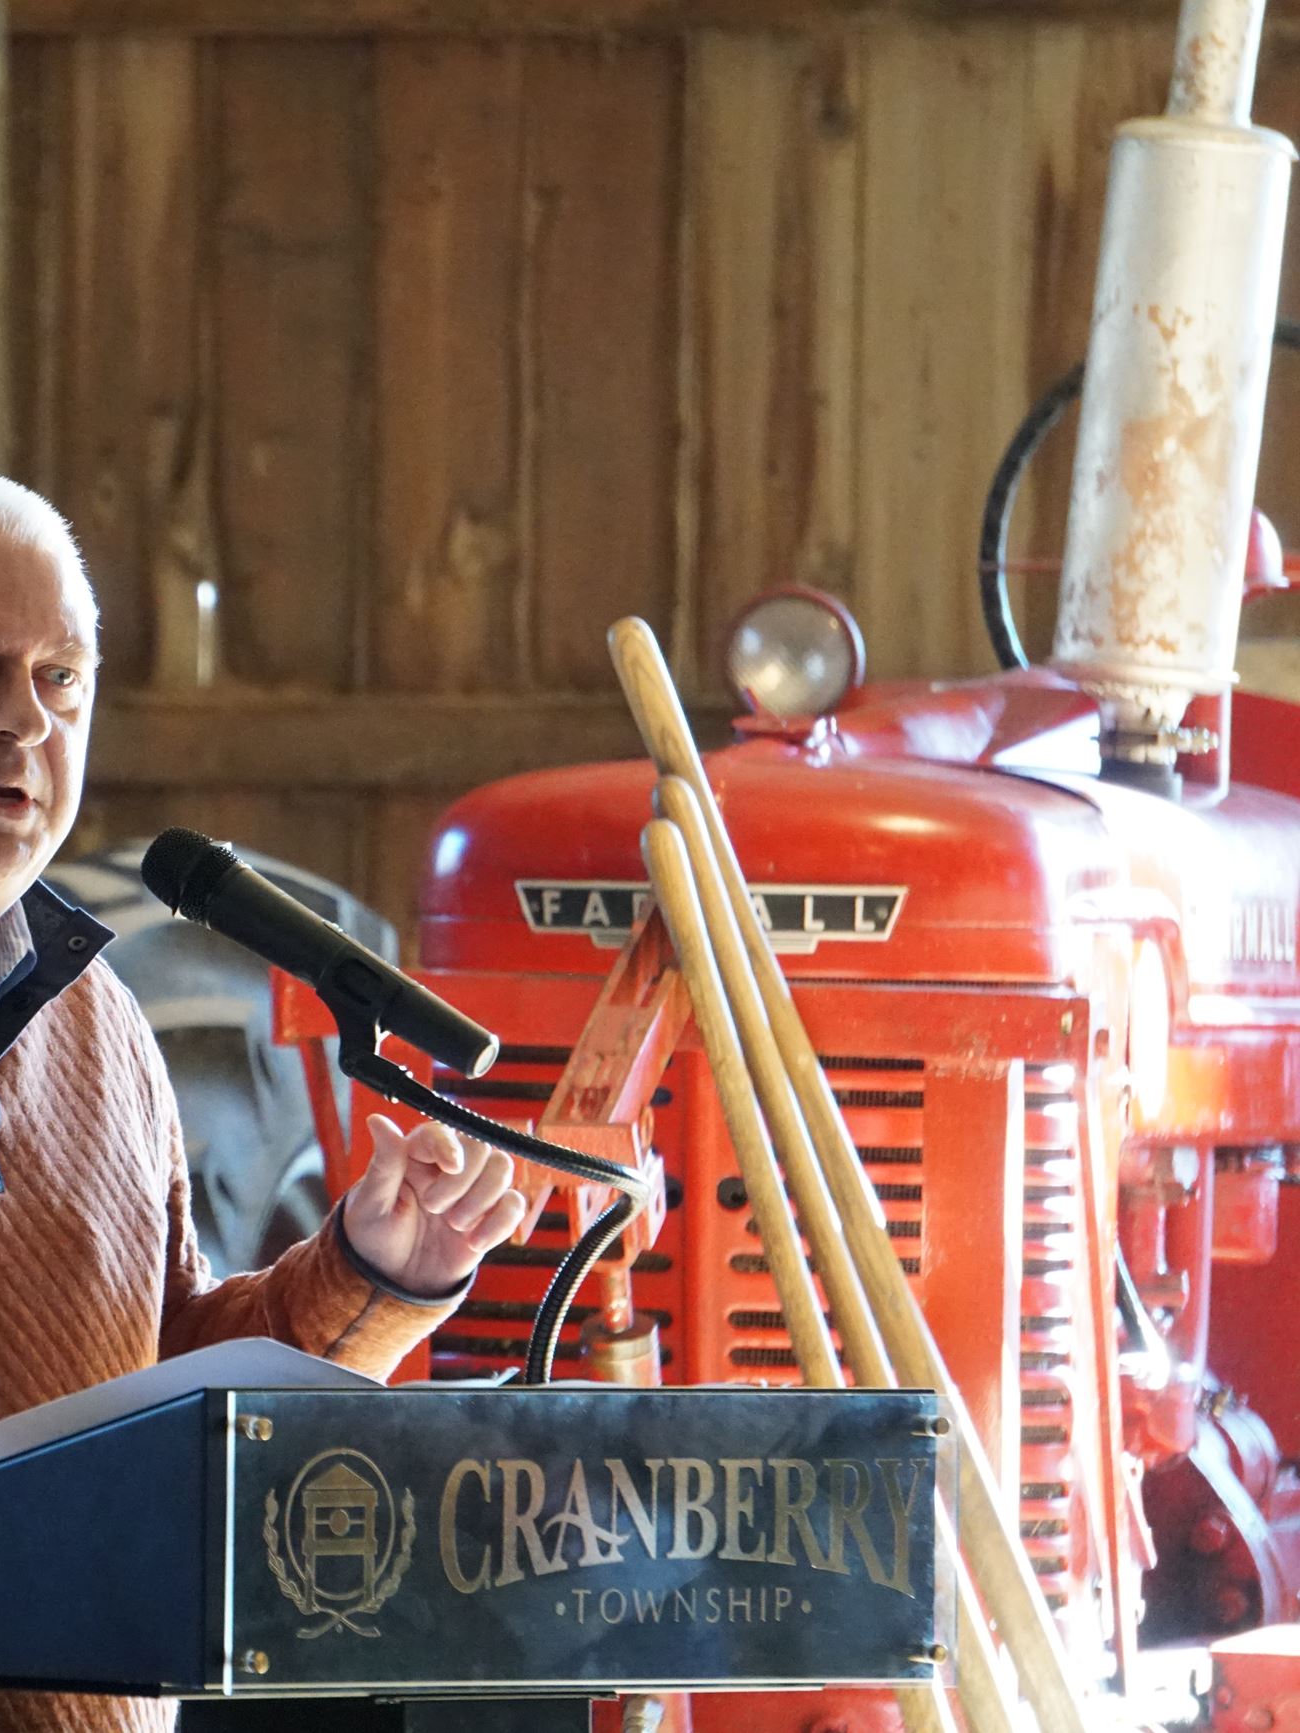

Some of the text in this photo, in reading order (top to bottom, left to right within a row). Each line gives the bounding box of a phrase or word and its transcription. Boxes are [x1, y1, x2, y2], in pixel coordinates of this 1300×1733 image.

[542, 891, 876, 932] FALL
[439, 1457, 929, 1600] CRANBERRY
[571, 1587, 794, 1625] TOWNSHIP
